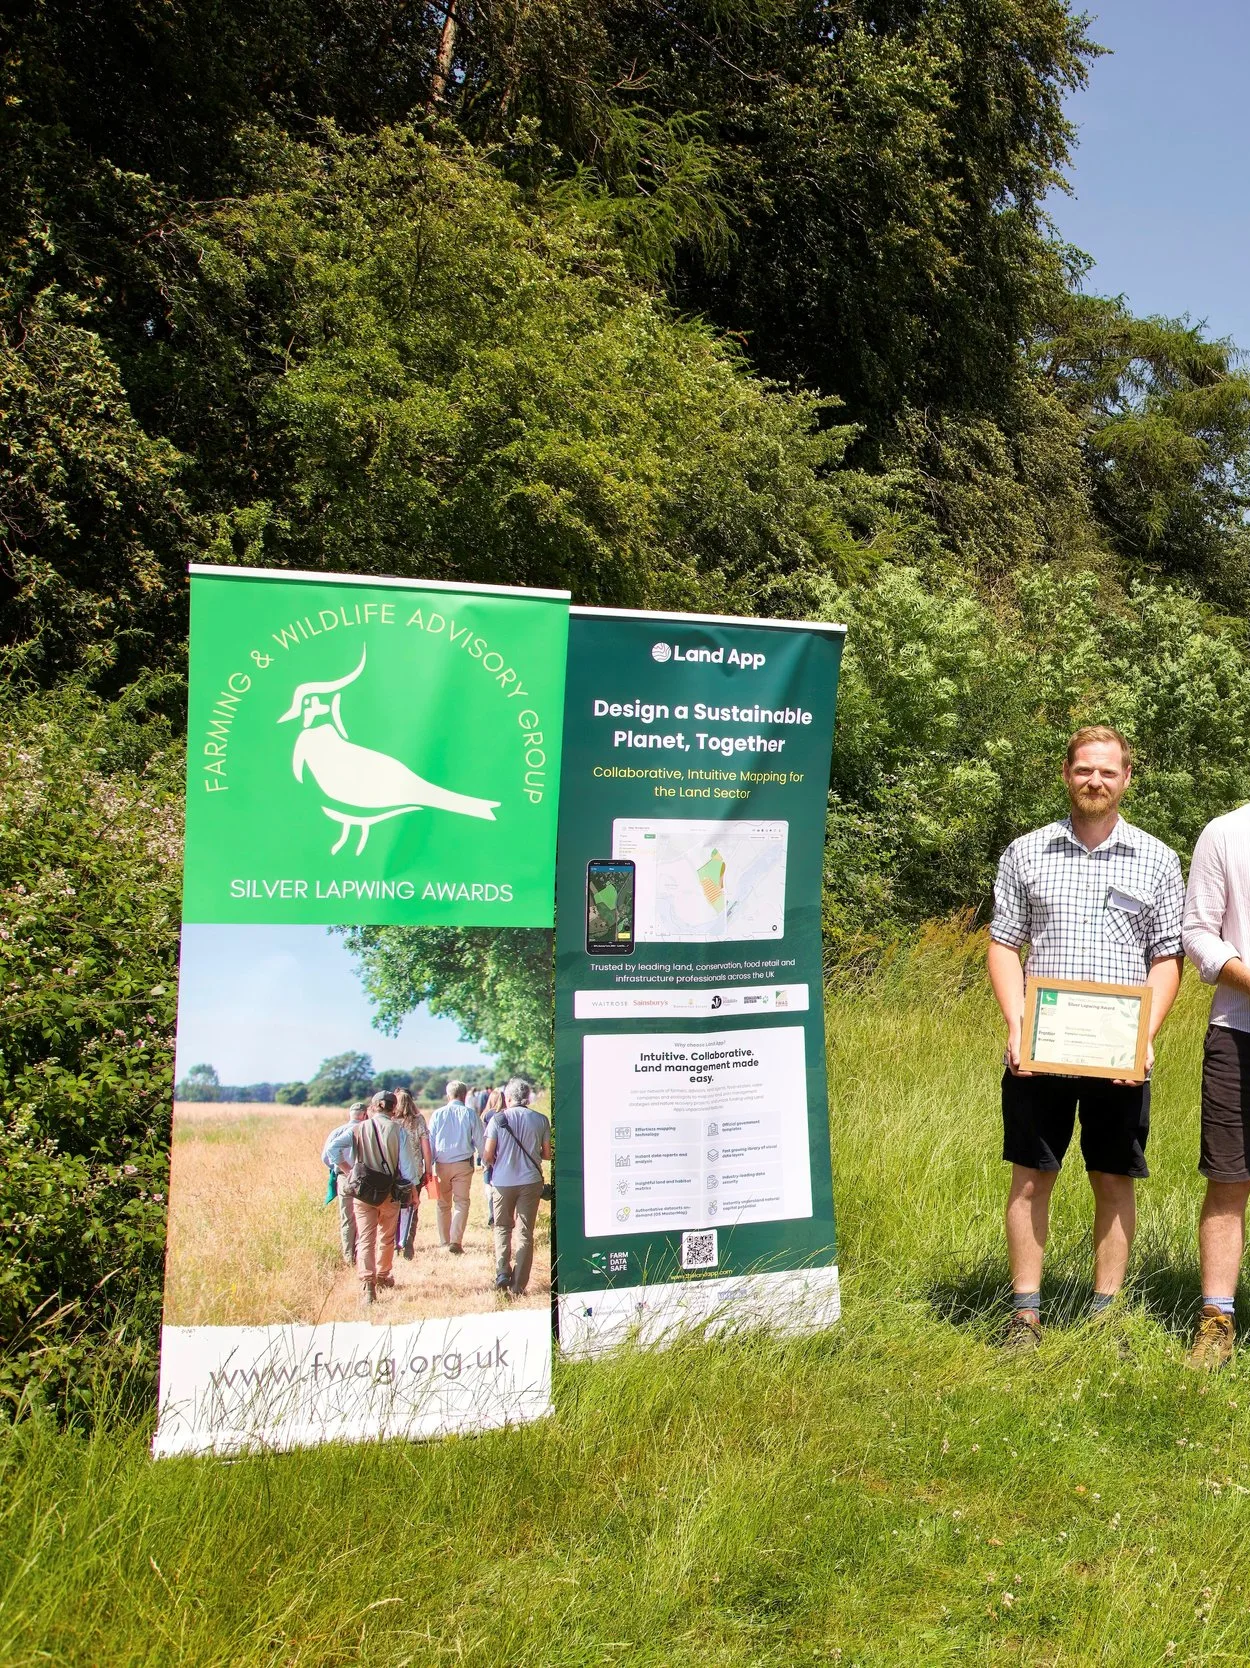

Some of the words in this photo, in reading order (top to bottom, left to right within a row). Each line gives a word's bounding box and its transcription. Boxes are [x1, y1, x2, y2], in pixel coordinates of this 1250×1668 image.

[673, 645, 724, 664] Land
[727, 648, 766, 670] App
[203, 672, 252, 793] FARMING
[250, 650, 275, 669] &
[272, 603, 396, 650] WILDLIFE
[406, 608, 529, 700] ADVISORY
[518, 709, 546, 804] GROUP
[593, 699, 670, 724] Design
[674, 705, 689, 720] a
[694, 703, 813, 725] Sustainable
[613, 730, 691, 752] Planet,
[696, 733, 786, 756] Together
[593, 766, 685, 782] Collaborative,
[687, 769, 737, 782] Intuitive
[740, 771, 787, 785] Mapping
[788, 772, 804, 782] for
[654, 786, 676, 798] the
[679, 787, 710, 798] Land
[714, 787, 751, 799] Sector
[229, 879, 309, 900] SILVER
[315, 880, 416, 902] LAPWING
[421, 882, 514, 903] AWARDS
[590, 963, 624, 971] Trusted
[625, 963, 636, 972] by
[638, 963, 670, 972] leading
[672, 963, 694, 972] land,
[696, 962, 742, 971] conservation,
[744, 960, 760, 968] food
[676, 974, 726, 984] professionals
[640, 1052, 688, 1062] Intuitive.
[690, 1048, 755, 1061] Collaborative.
[634, 1063, 662, 1072] Land
[664, 1060, 731, 1074] management
[732, 1059, 760, 1069] made
[689, 1075, 714, 1084] easy.
[209, 1337, 510, 1390] www.fwag.org.uk
